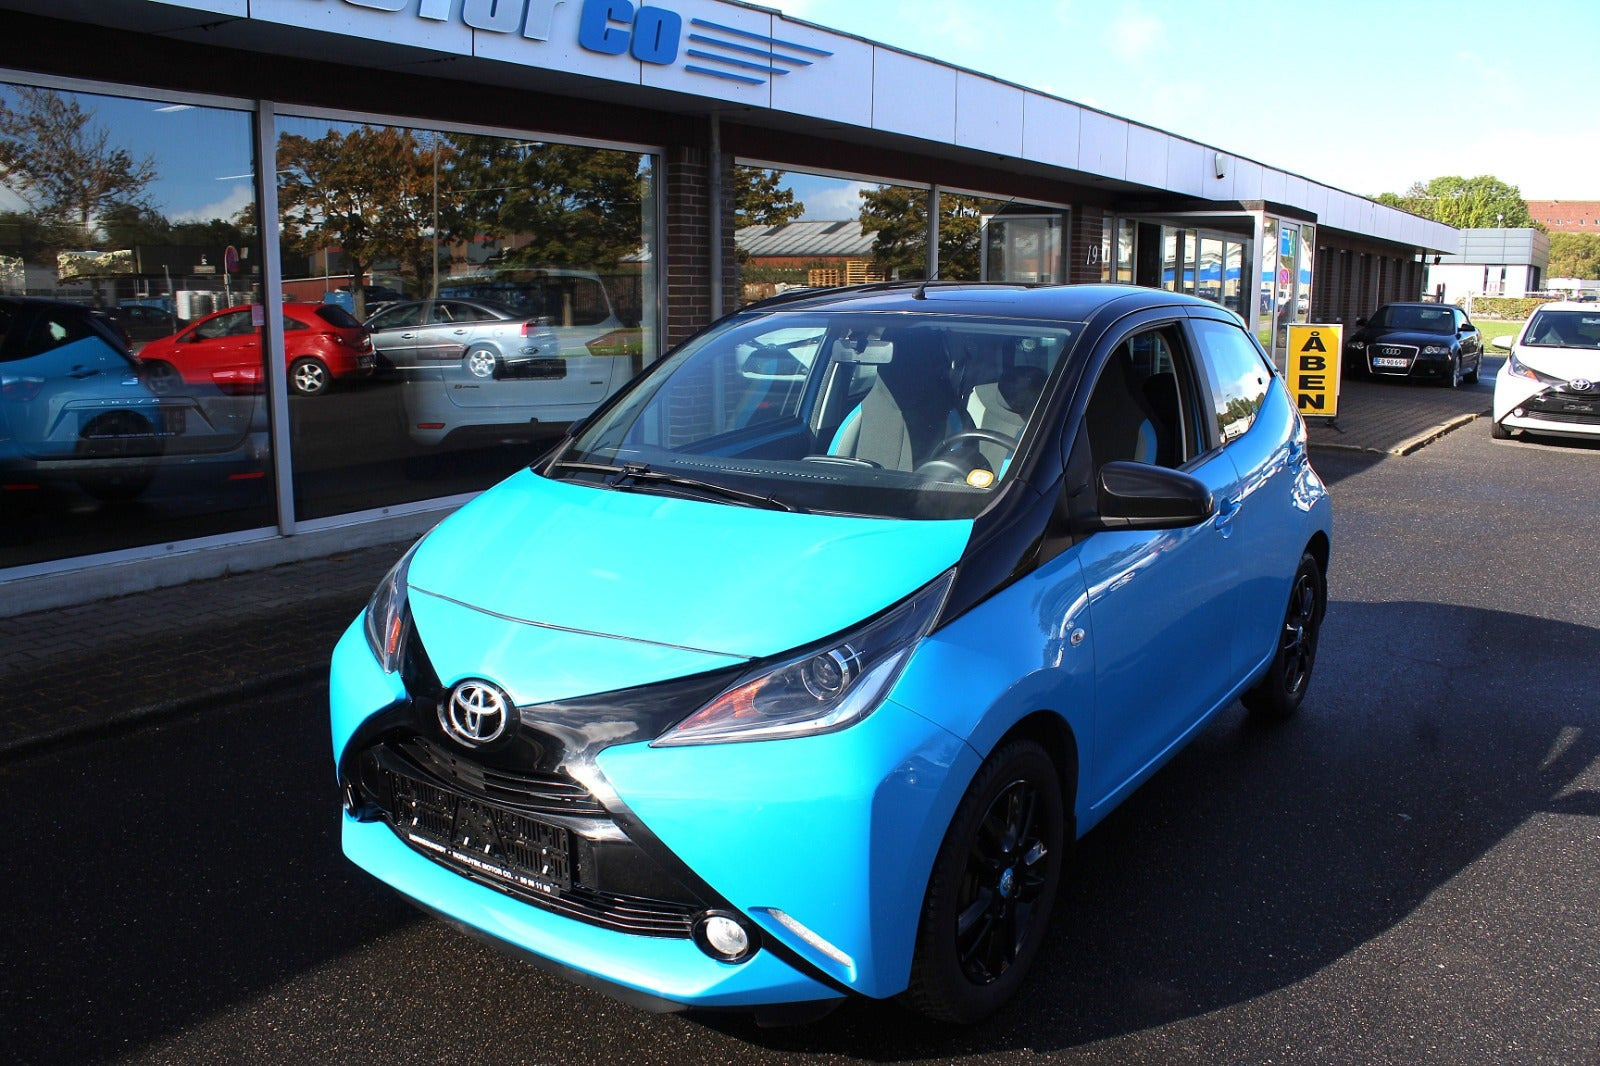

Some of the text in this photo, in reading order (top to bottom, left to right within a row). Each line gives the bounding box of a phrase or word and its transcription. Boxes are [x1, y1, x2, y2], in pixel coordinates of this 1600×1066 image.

[1086, 244, 1098, 265] 19
[1297, 330, 1327, 410] ÅBEN
[482, 862, 503, 876] MOTOR
